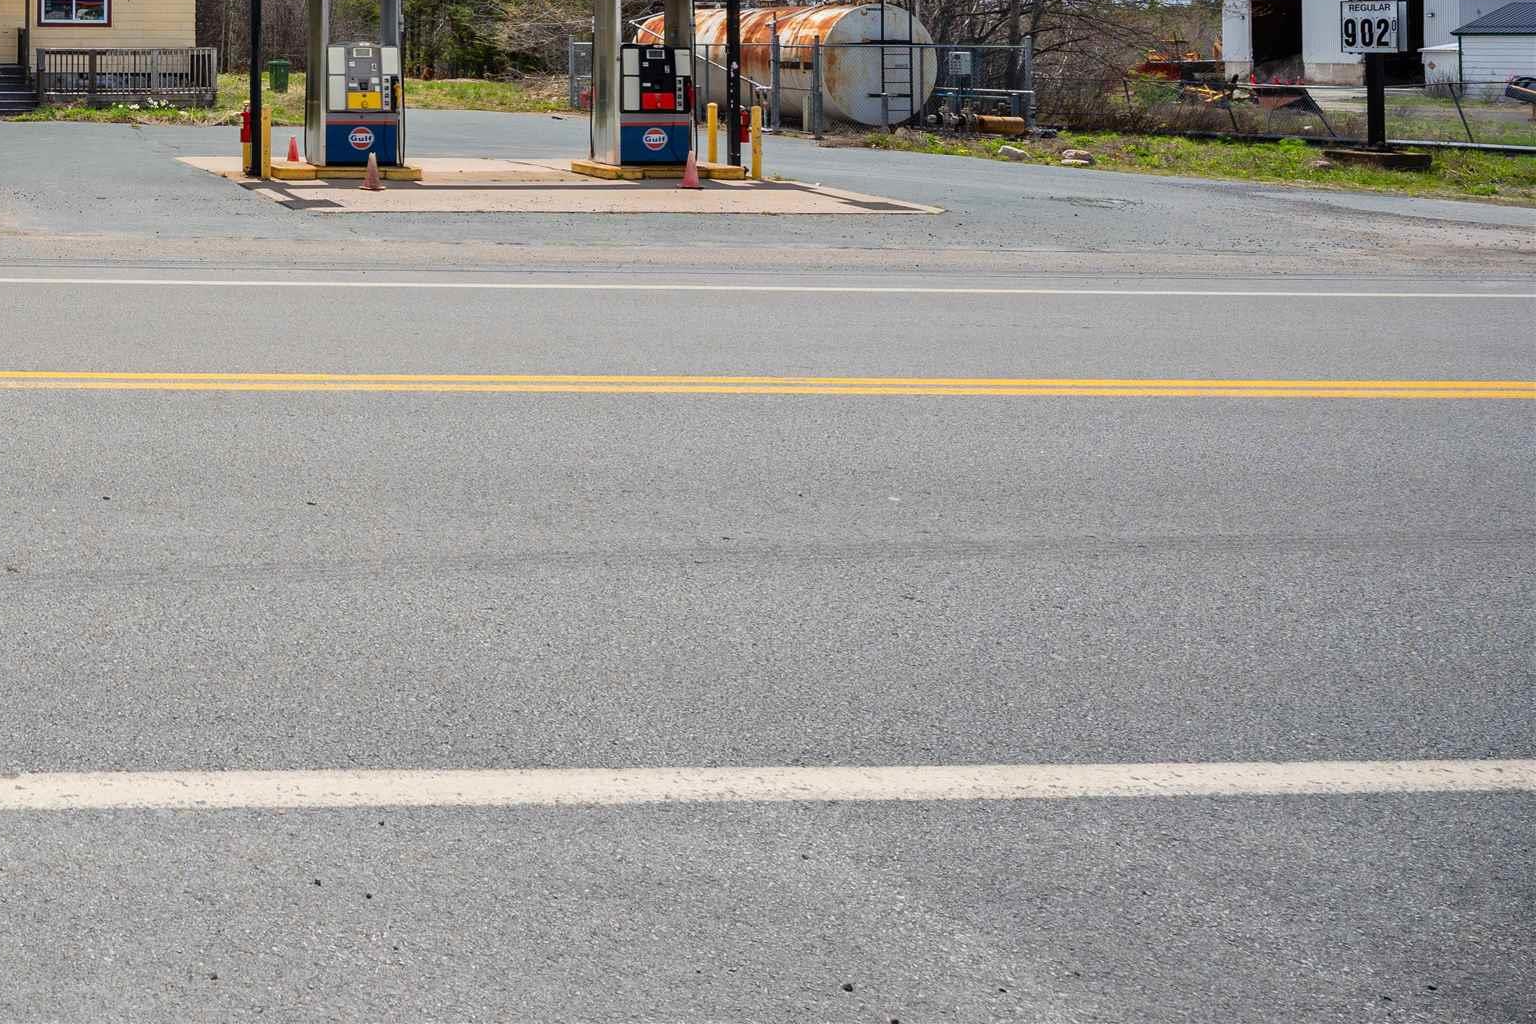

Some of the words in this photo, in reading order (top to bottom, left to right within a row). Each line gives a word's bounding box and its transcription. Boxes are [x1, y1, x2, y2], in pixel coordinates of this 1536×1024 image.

[1348, 3, 1391, 12] REGULAR
[1344, 18, 1390, 47] 902
[351, 134, 374, 143] Gulf
[644, 135, 666, 144] Gulf
